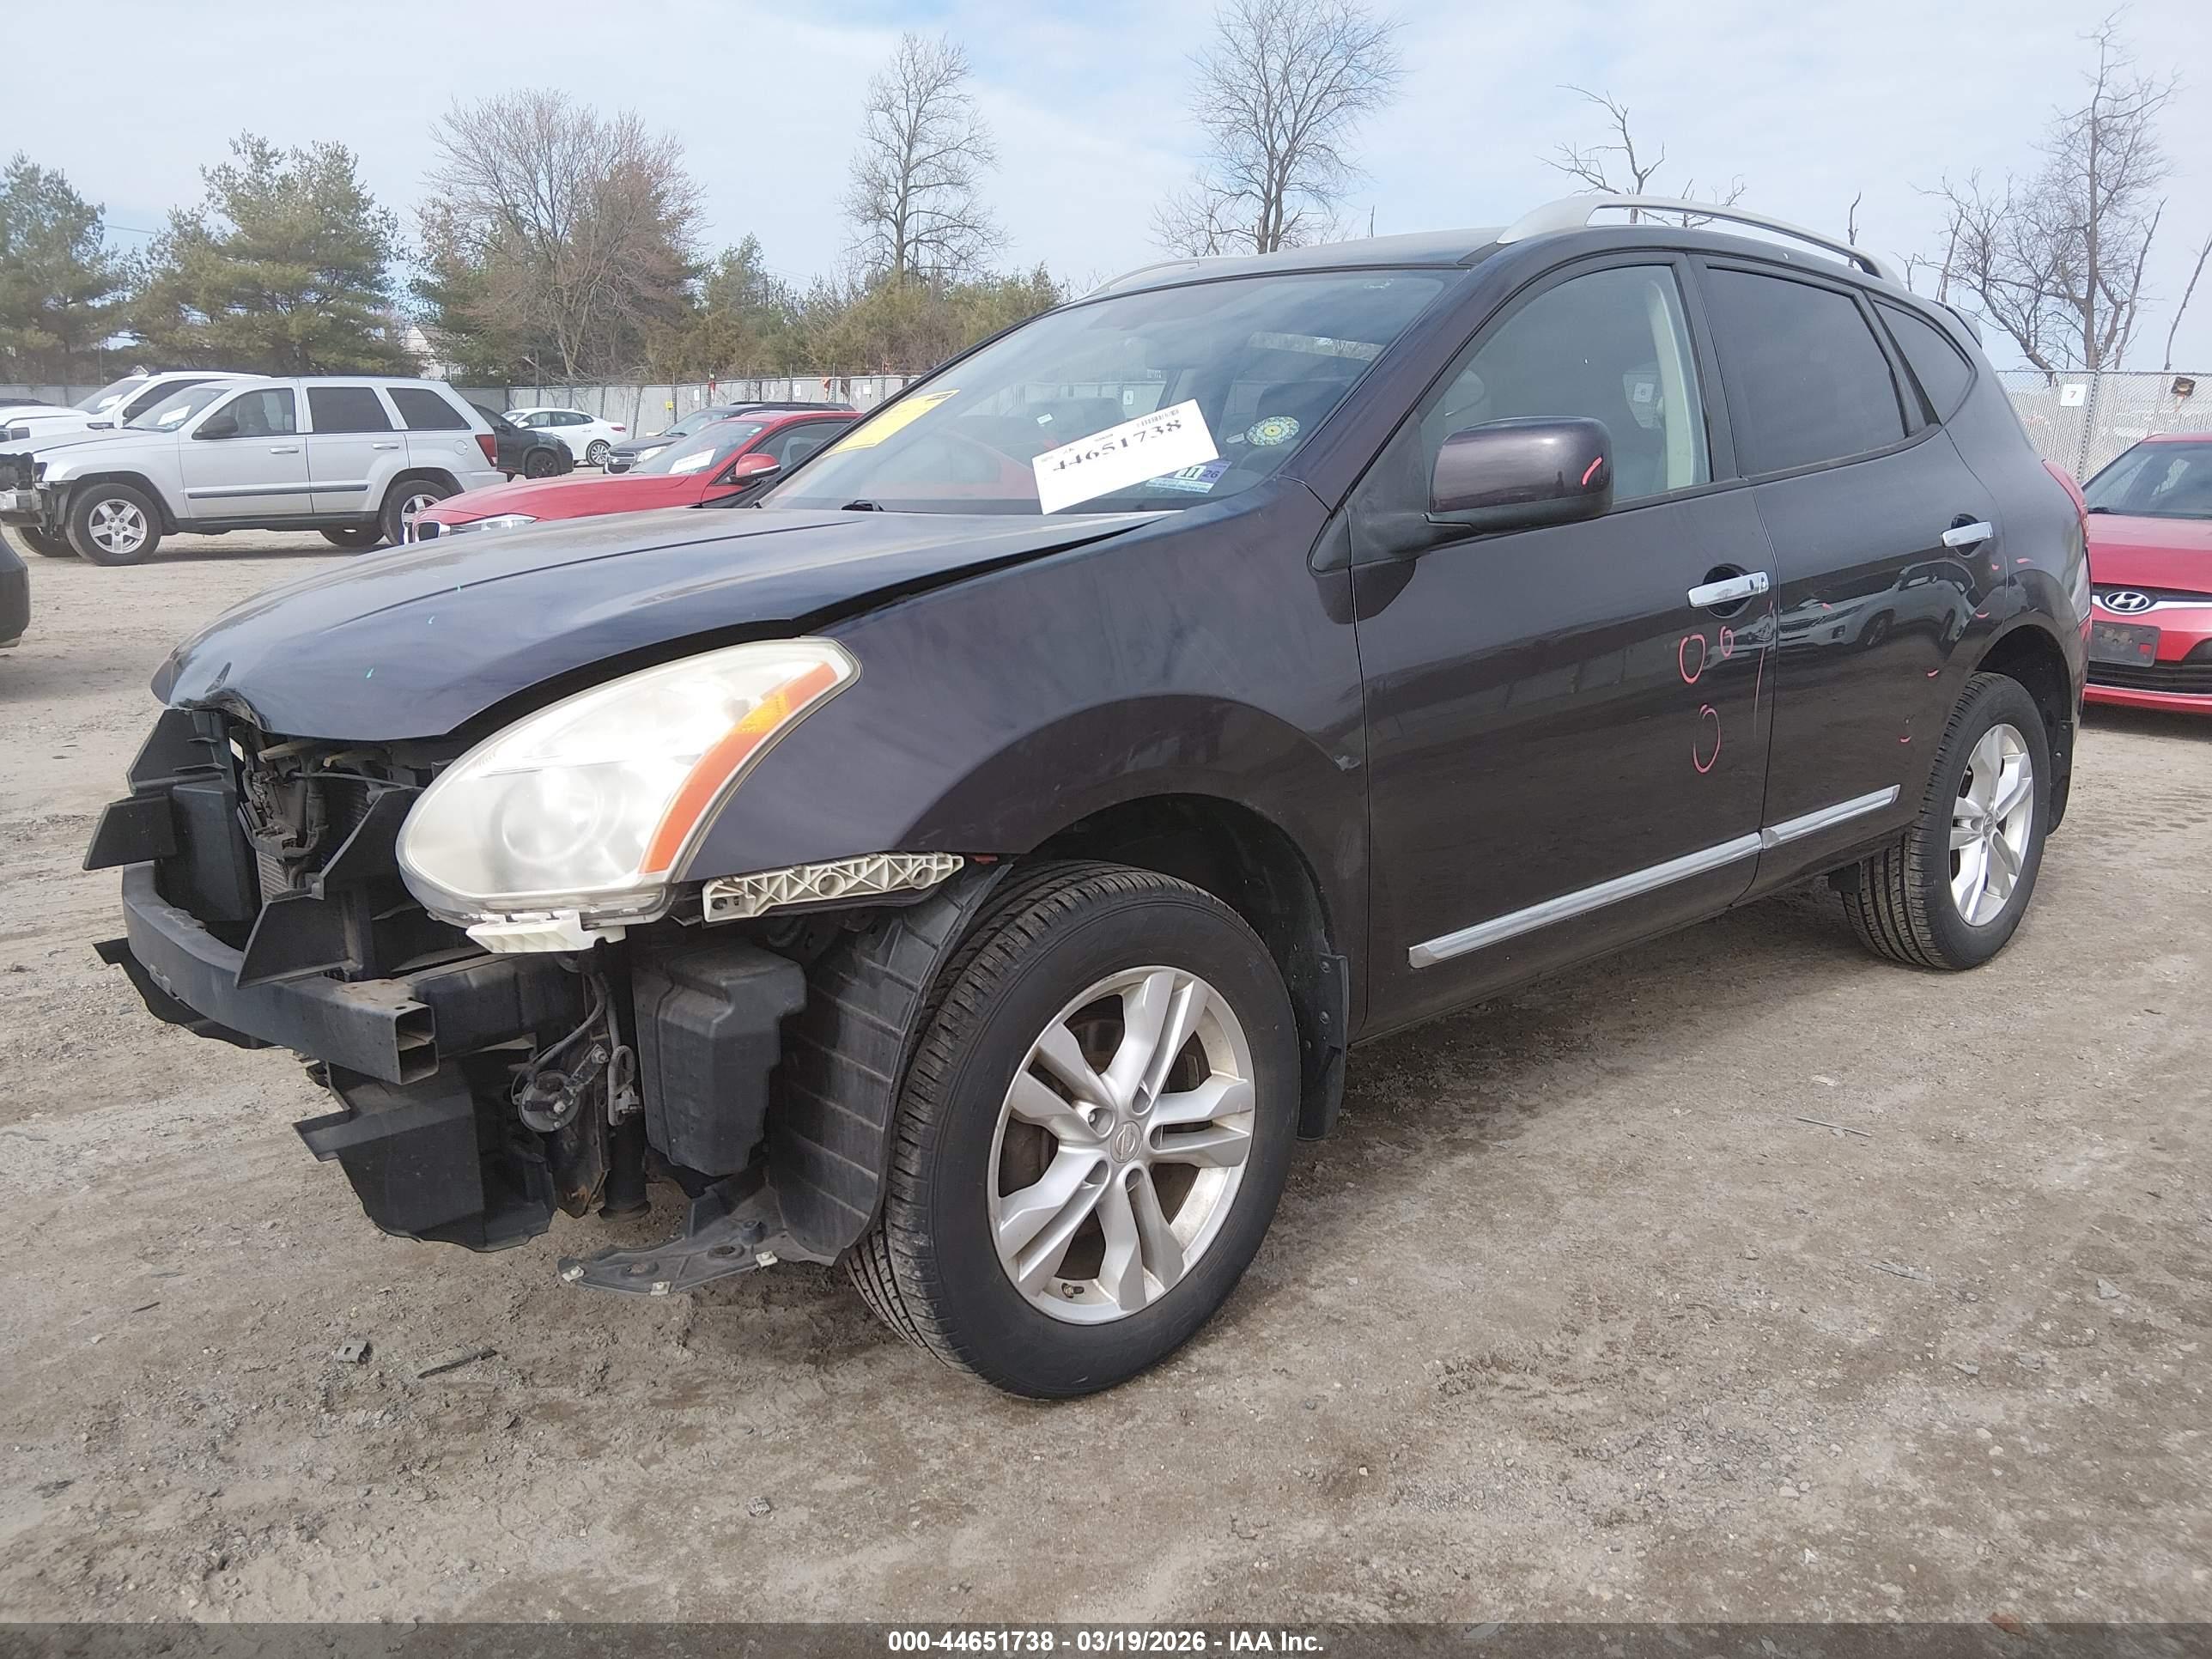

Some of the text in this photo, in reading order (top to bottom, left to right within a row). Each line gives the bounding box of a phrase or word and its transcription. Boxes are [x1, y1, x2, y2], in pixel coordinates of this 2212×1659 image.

[2070, 390, 2076, 398] 7
[1180, 466, 1220, 478] 11 26
